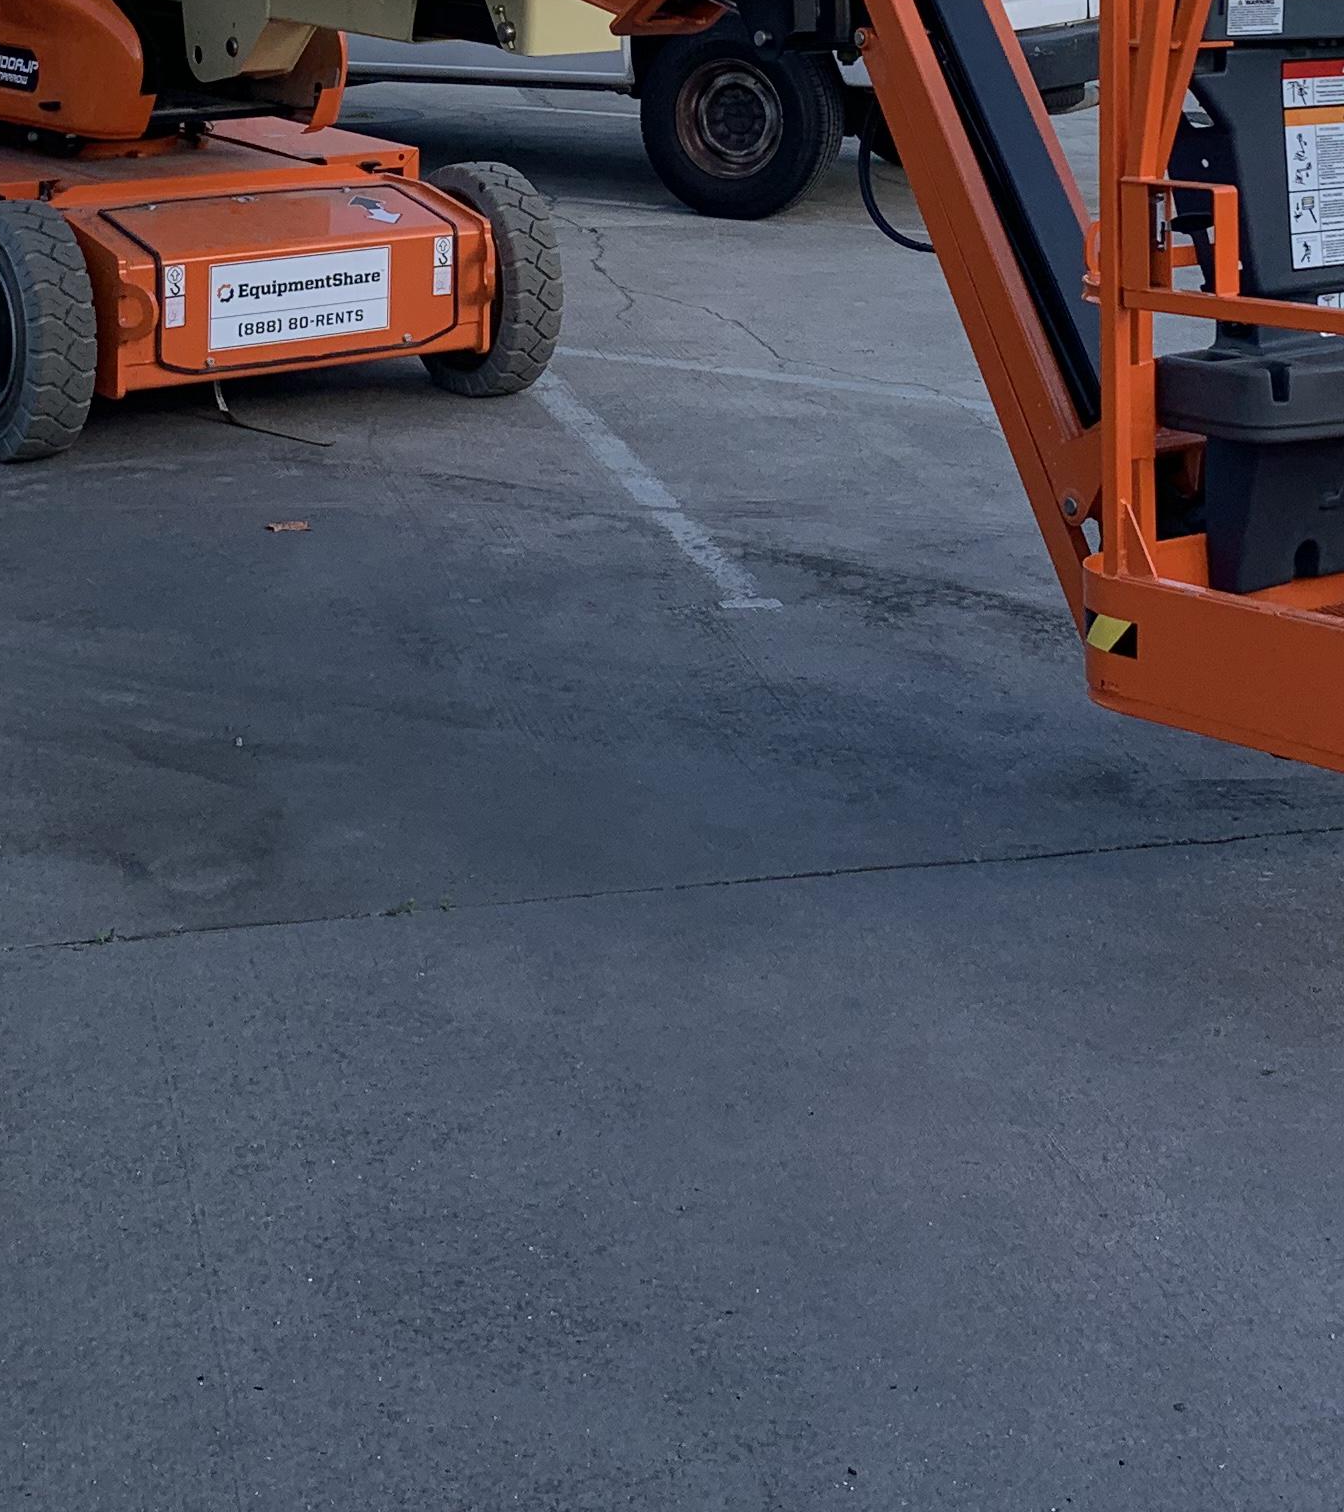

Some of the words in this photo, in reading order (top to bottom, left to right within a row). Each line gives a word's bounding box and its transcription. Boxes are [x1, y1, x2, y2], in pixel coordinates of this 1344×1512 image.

[238, 271, 381, 299] EquipmentShare
[238, 317, 282, 337] (888)
[288, 309, 364, 332] 80-RENTS
